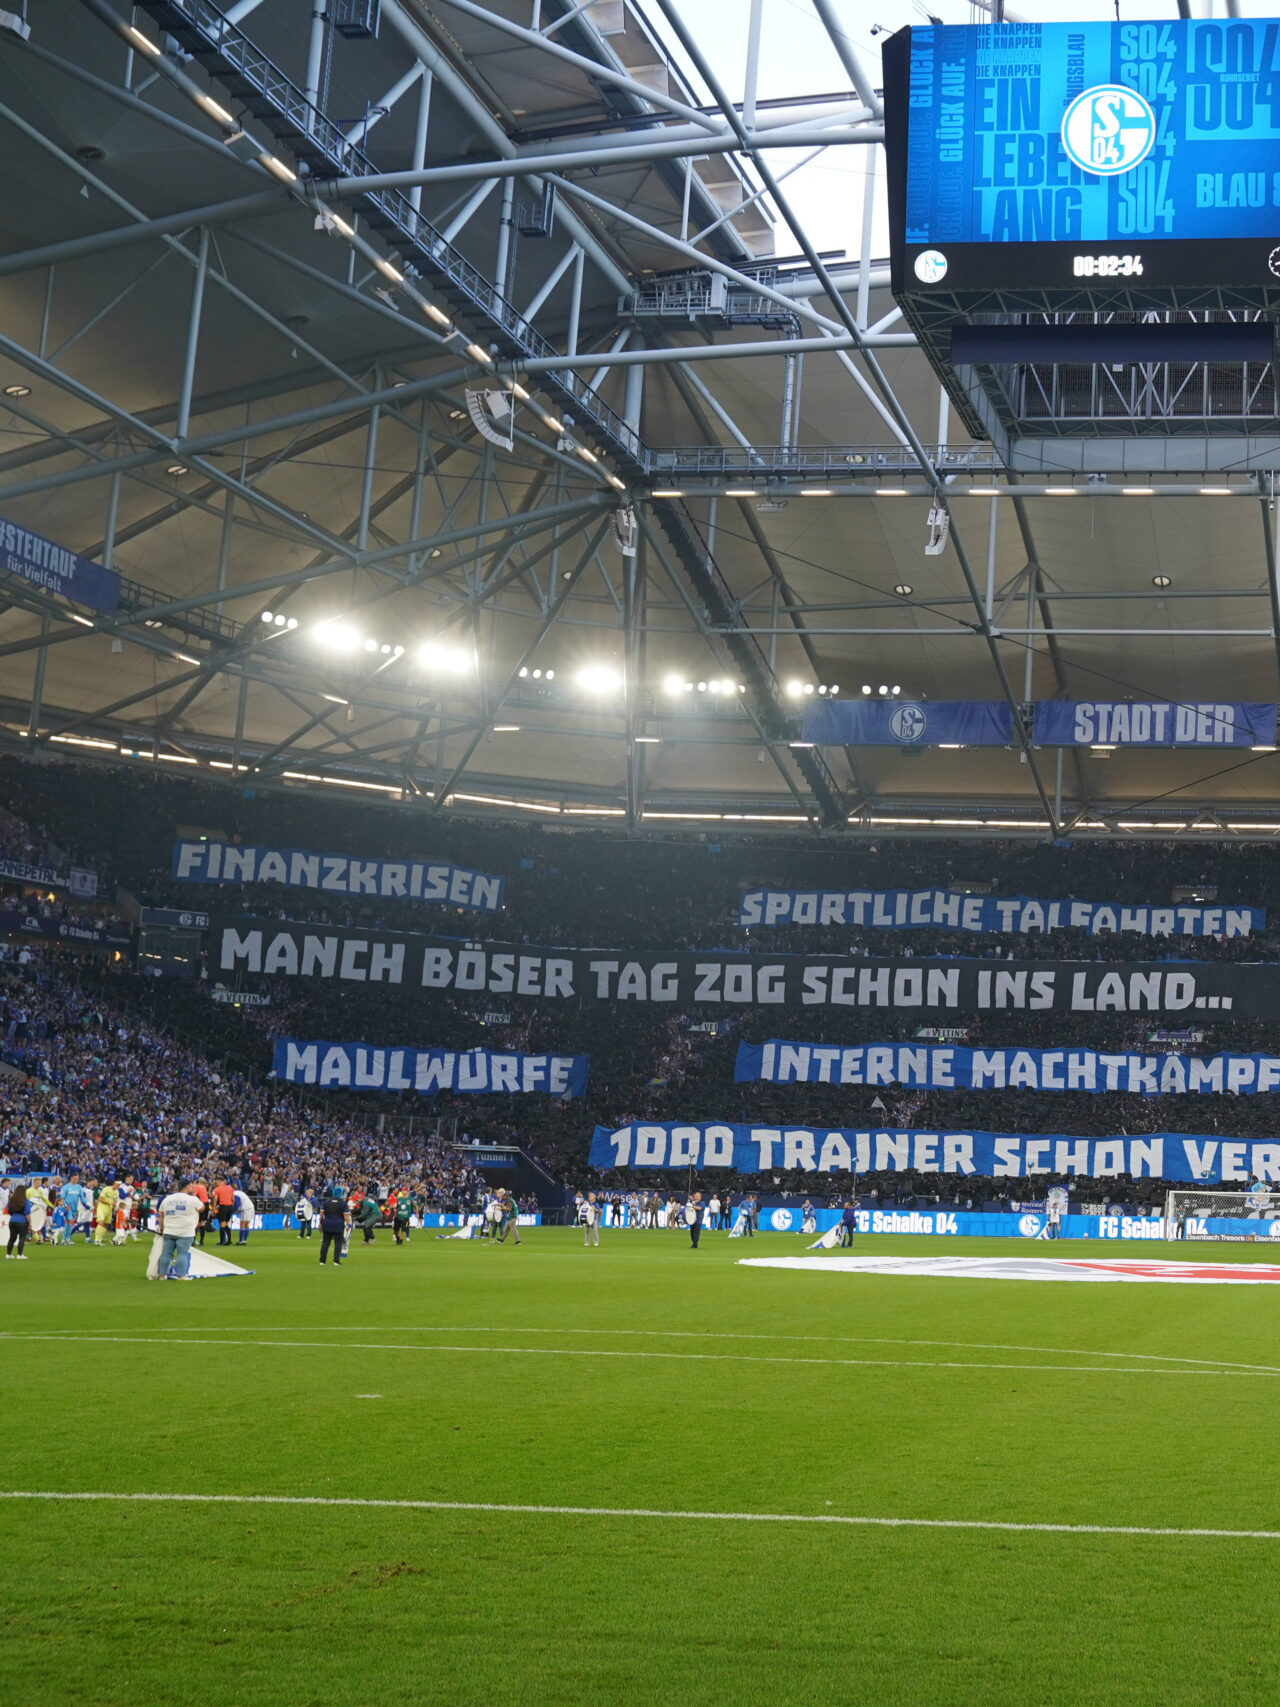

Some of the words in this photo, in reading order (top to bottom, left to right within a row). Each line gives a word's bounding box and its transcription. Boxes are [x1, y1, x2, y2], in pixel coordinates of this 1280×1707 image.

[994, 23, 1042, 36] KNAPPEN
[994, 36, 1042, 49] KNAPPEN
[1120, 24, 1177, 60] S04
[941, 58, 966, 97] AUF.
[993, 64, 1041, 76] KNAPPEN
[975, 78, 1040, 131] EIN
[936, 102, 964, 162] GLÜCK
[1196, 172, 1266, 208] BLAU
[973, 187, 1082, 242] LANG
[1074, 255, 1144, 277] 00:02:34
[7, 554, 22, 572] für
[24, 561, 62, 592] Vielfalt
[1074, 703, 1170, 743] STADT
[1176, 704, 1234, 743] DER
[176, 843, 500, 910] FINANZKRISEN
[740, 892, 983, 932] SPORTLICHE
[996, 900, 1252, 938] TALFAHRTEN
[220, 928, 405, 984] MANCH
[421, 942, 575, 998] BÖSER
[590, 960, 678, 1001] TAG
[694, 963, 785, 1003] ZOG
[802, 966, 960, 1007] SCHON
[977, 971, 1056, 1010] INS
[1071, 971, 1232, 1011] LAND...
[286, 1042, 574, 1093] MAULWÜRFE
[761, 1043, 954, 1086] INTERNE
[475, 1152, 507, 1161] Tunnel
[610, 1126, 734, 1167] 1000
[751, 1129, 976, 1174] TRAINER
[993, 1138, 1164, 1179] SCHON
[872, 1210, 932, 1234] Schalke
[936, 1213, 958, 1234] 04
[1099, 1217, 1119, 1238] FC
[1122, 1217, 1182, 1239] Schal
